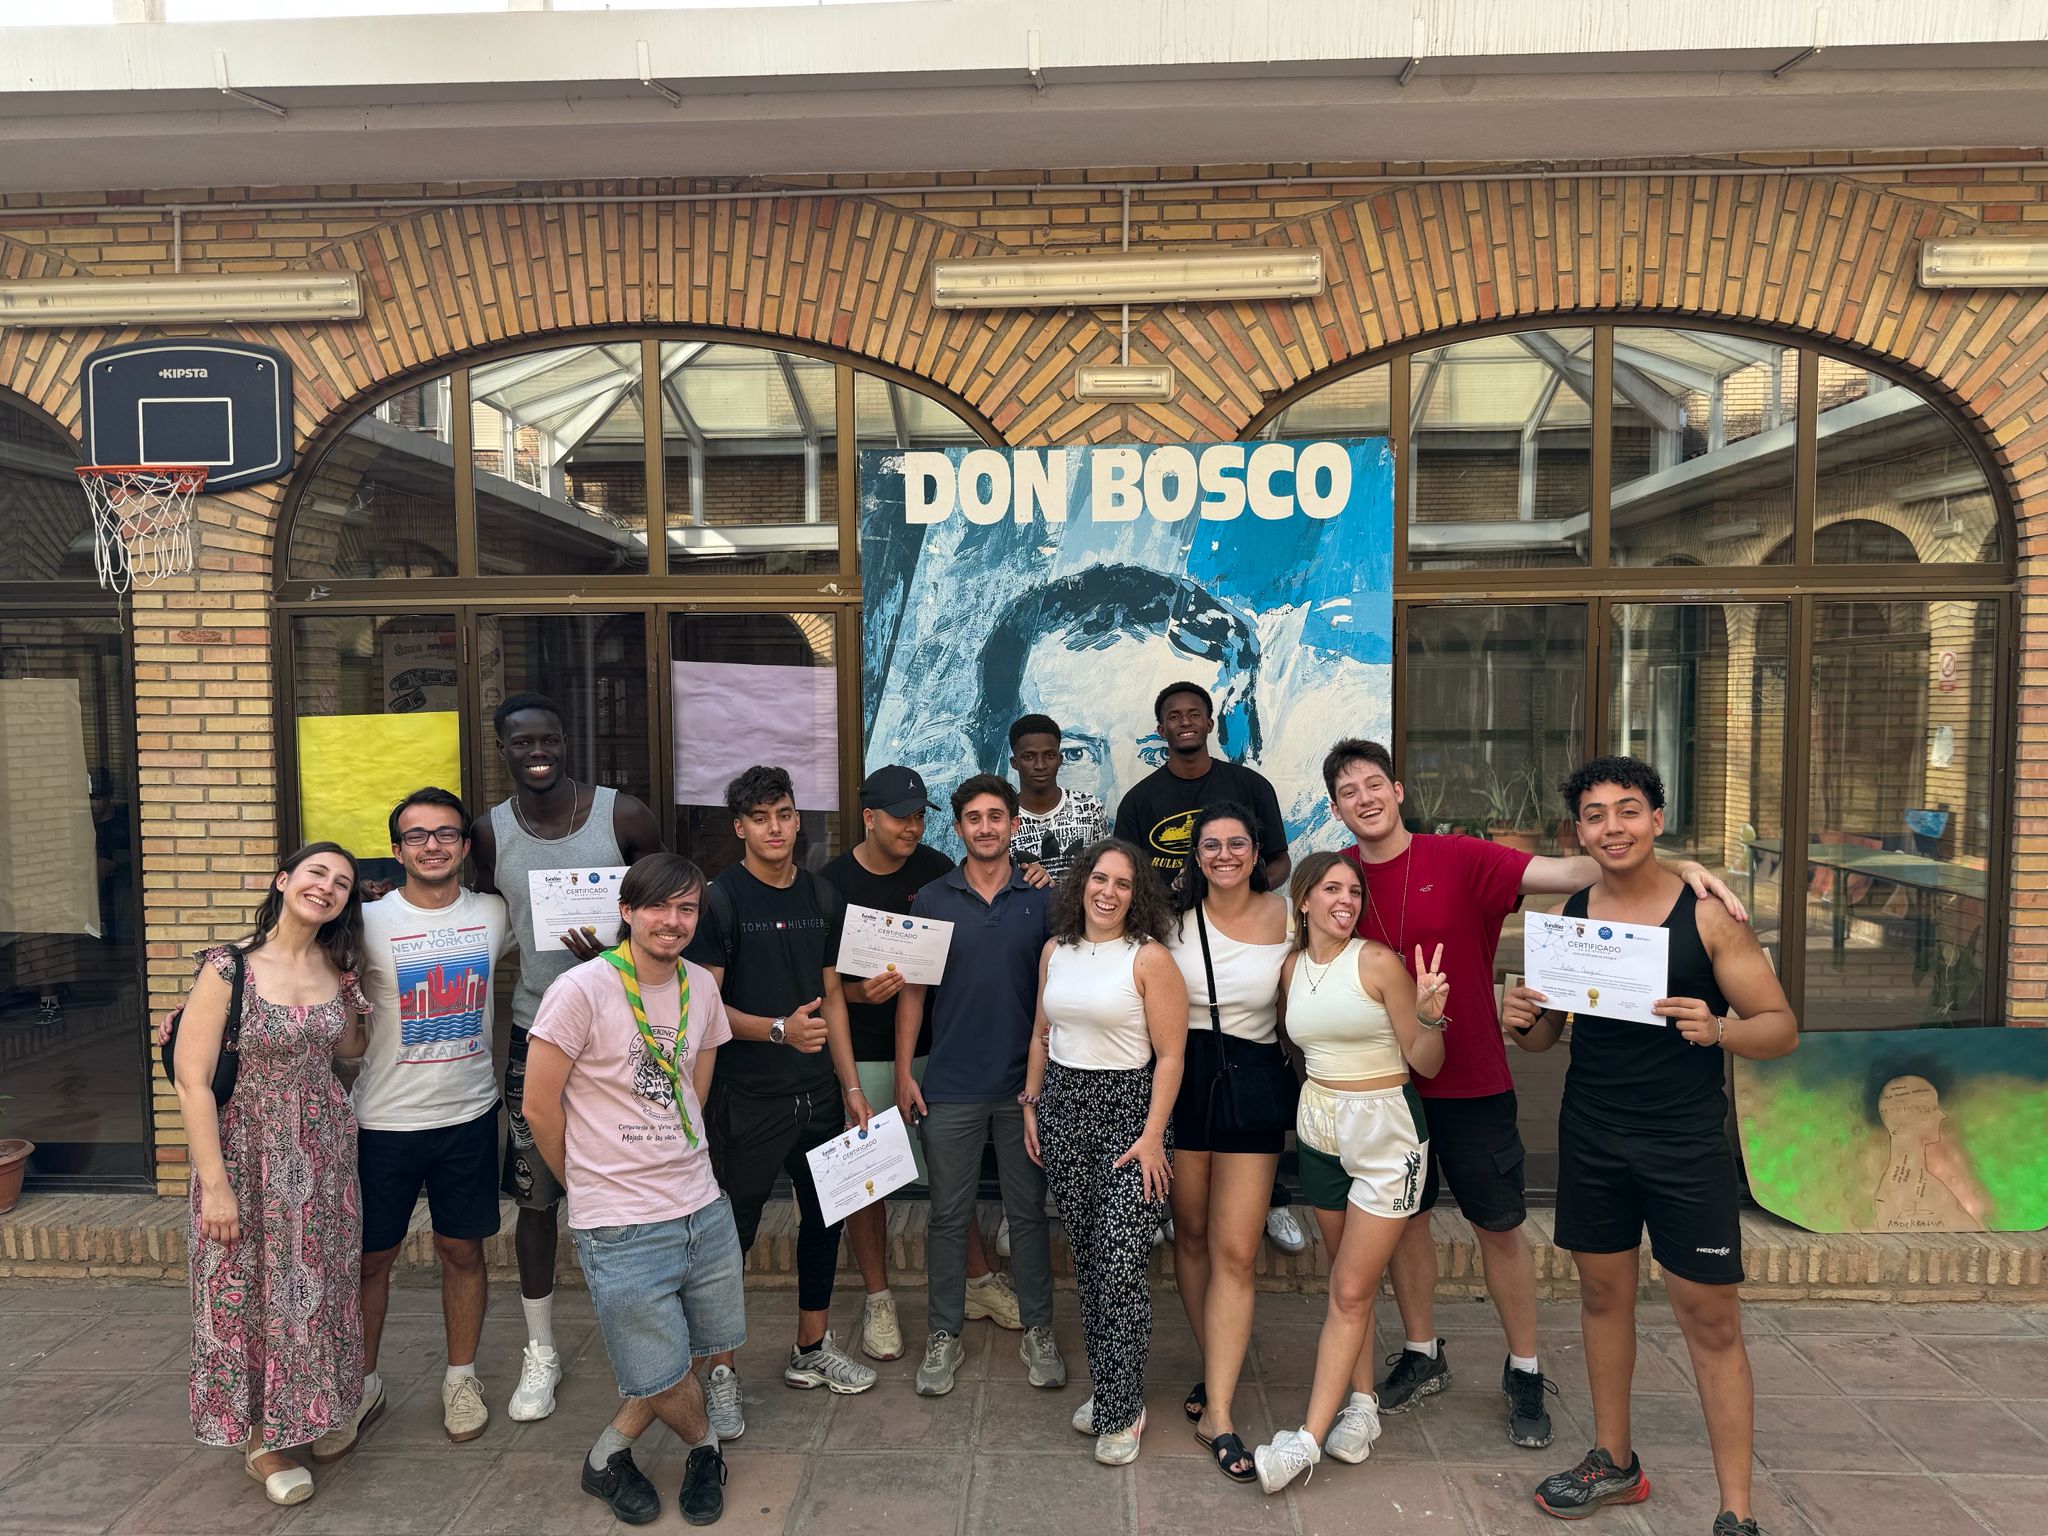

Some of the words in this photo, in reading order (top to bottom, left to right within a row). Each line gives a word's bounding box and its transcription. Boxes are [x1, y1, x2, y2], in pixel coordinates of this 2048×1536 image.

[904, 450, 1068, 525] DON
[1091, 442, 1352, 522] BOSCO
[1151, 857, 1184, 869] RULES
[565, 887, 609, 895] CERTIFICADO
[742, 921, 774, 932] TOMMY
[788, 918, 825, 929] HILFIGER
[429, 928, 455, 938] TCS
[877, 928, 918, 940] CERTIFICADO
[391, 940, 424, 954] NEW
[427, 935, 463, 949] YORK
[464, 931, 489, 944] CITY
[1567, 940, 1622, 953] CERTIFICADO
[842, 1138, 878, 1161] CERTIFICADO
[1393, 1198, 1403, 1211] 65
